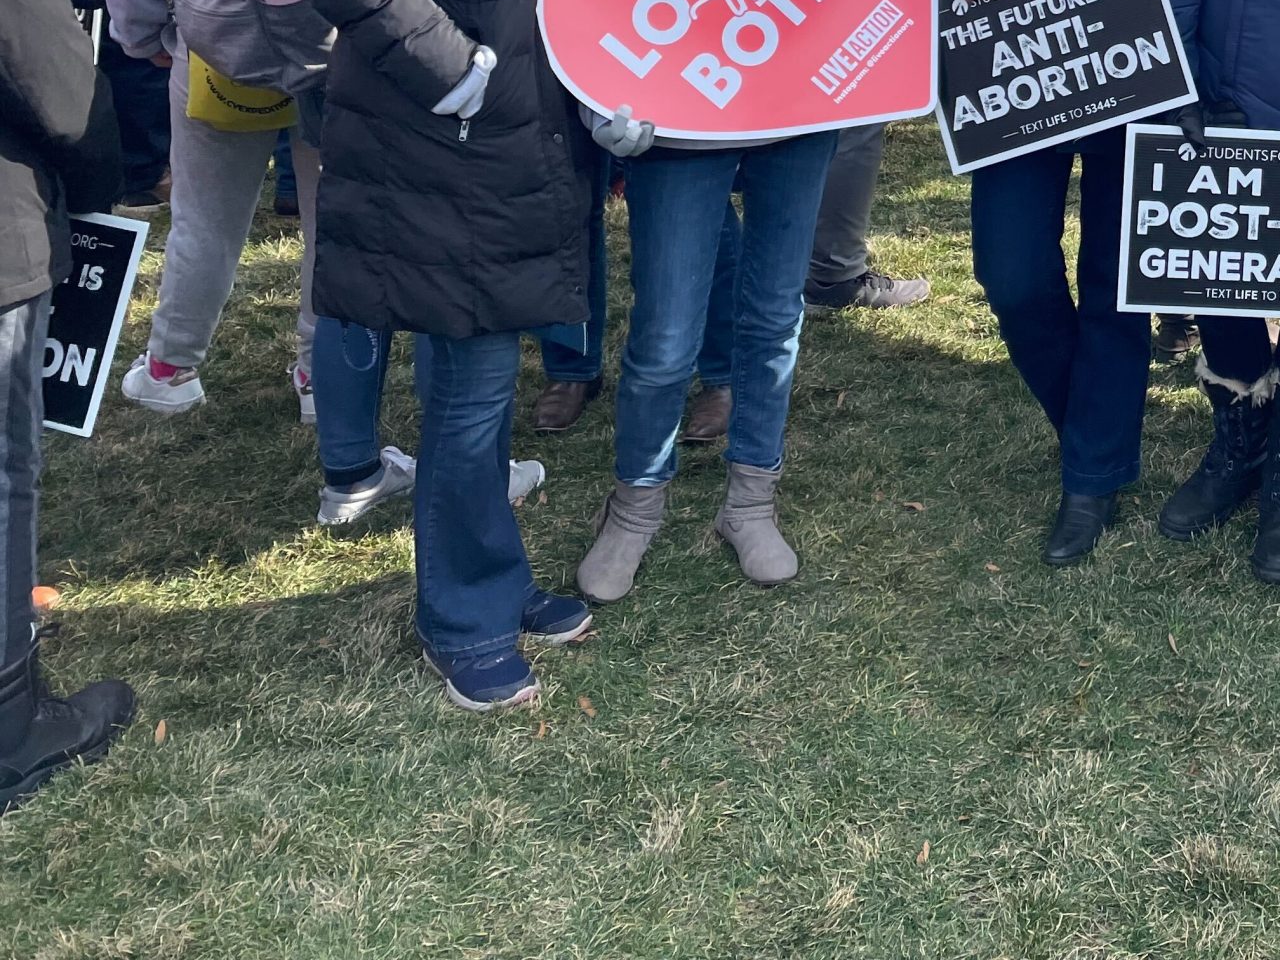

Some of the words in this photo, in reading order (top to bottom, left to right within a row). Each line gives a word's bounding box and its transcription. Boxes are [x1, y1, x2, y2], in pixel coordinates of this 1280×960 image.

[811, 47, 859, 96] LIVE
[846, 1, 901, 58] ACTION
[940, 17, 993, 50] THE
[991, 15, 1104, 77] ANTI-
[833, 66, 870, 105] Instagram:
[953, 30, 1171, 132] ABORTION
[1020, 119, 1044, 136] TEXT
[1046, 112, 1068, 129] LIFE
[1068, 108, 1083, 120] TO
[1085, 96, 1117, 116] 53445
[1152, 162, 1164, 192] I
[1187, 165, 1263, 197] AM
[78, 263, 105, 291] IS
[1205, 288, 1232, 300] TEXT
[1235, 289, 1258, 301] LIFE
[1261, 290, 1277, 302] TO
